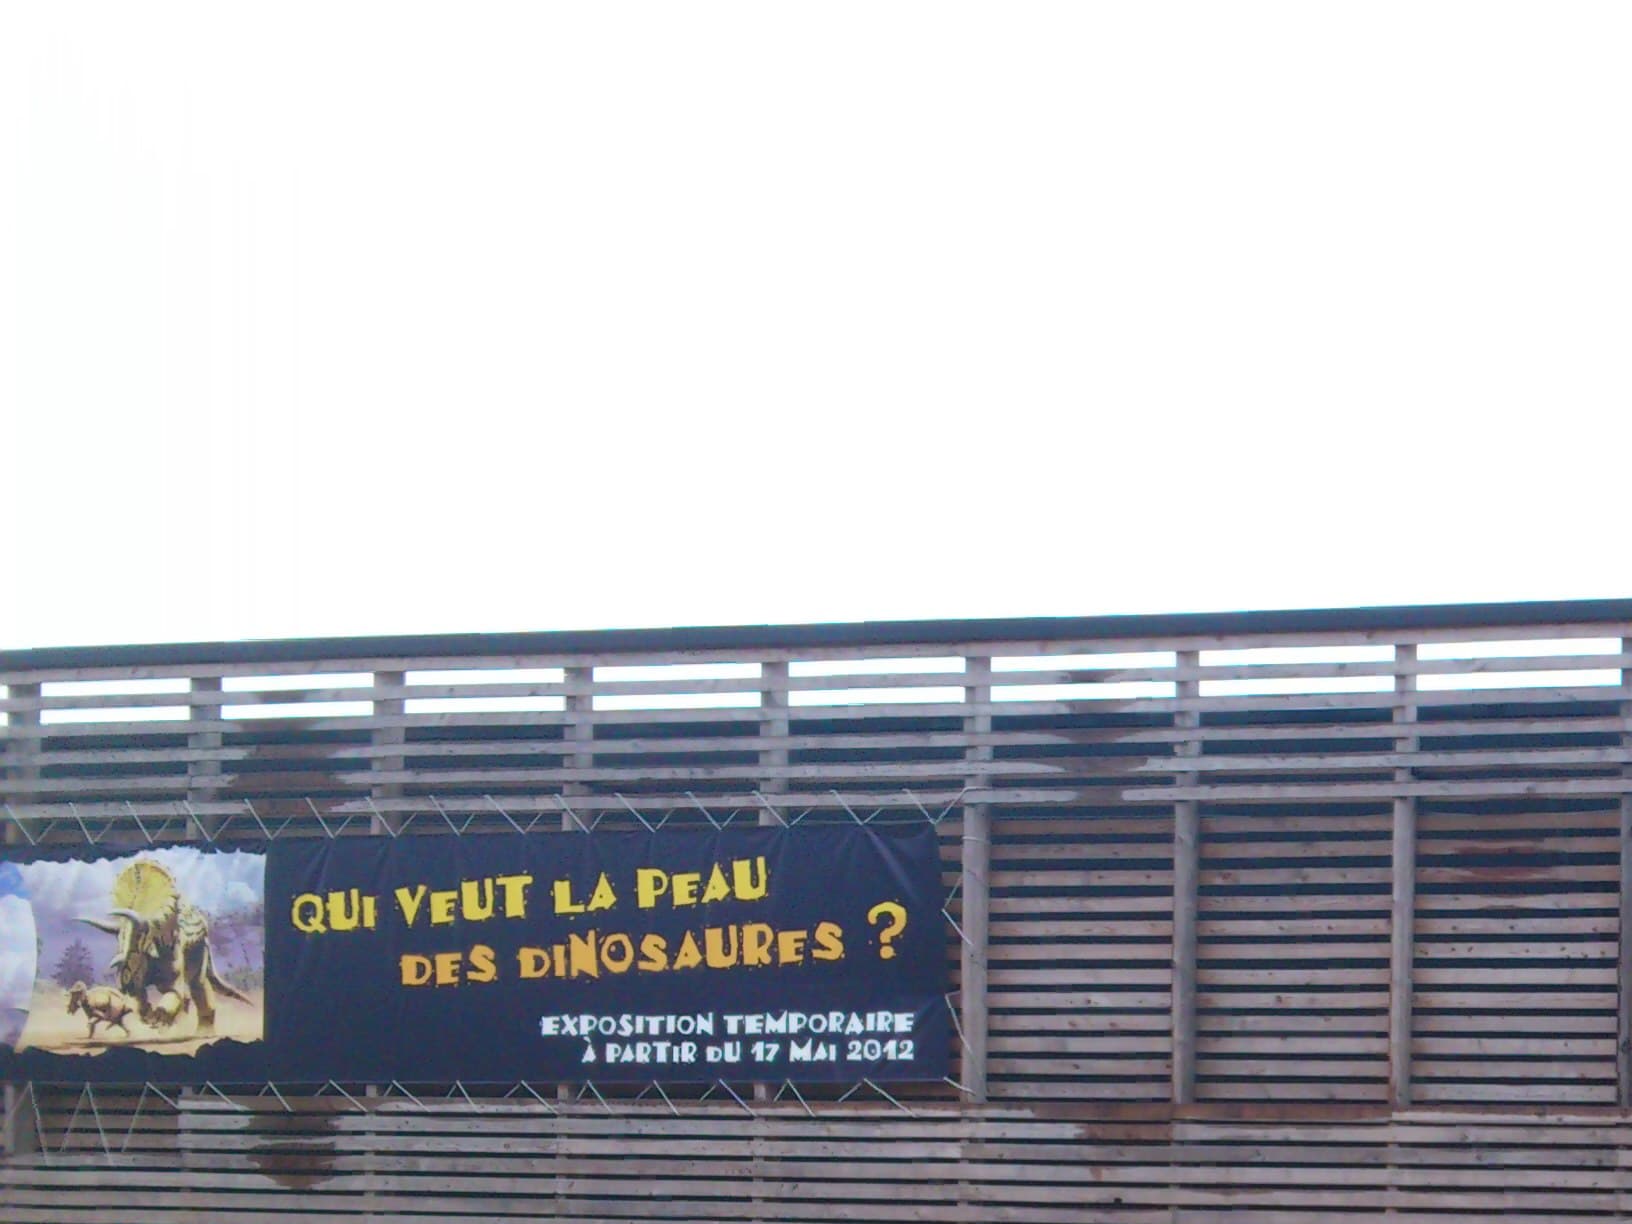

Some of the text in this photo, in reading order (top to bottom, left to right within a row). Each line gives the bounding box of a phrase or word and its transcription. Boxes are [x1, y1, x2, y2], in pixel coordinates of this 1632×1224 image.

[291, 855, 766, 934] QUI VEUT LA PEAU
[401, 944, 497, 986] DES
[518, 921, 844, 979] DINOSAURES
[541, 1010, 914, 1036] EXPOSITION TEMPORAIRE
[581, 1037, 914, 1063] À PARTIR DU 17 MAI 2012
